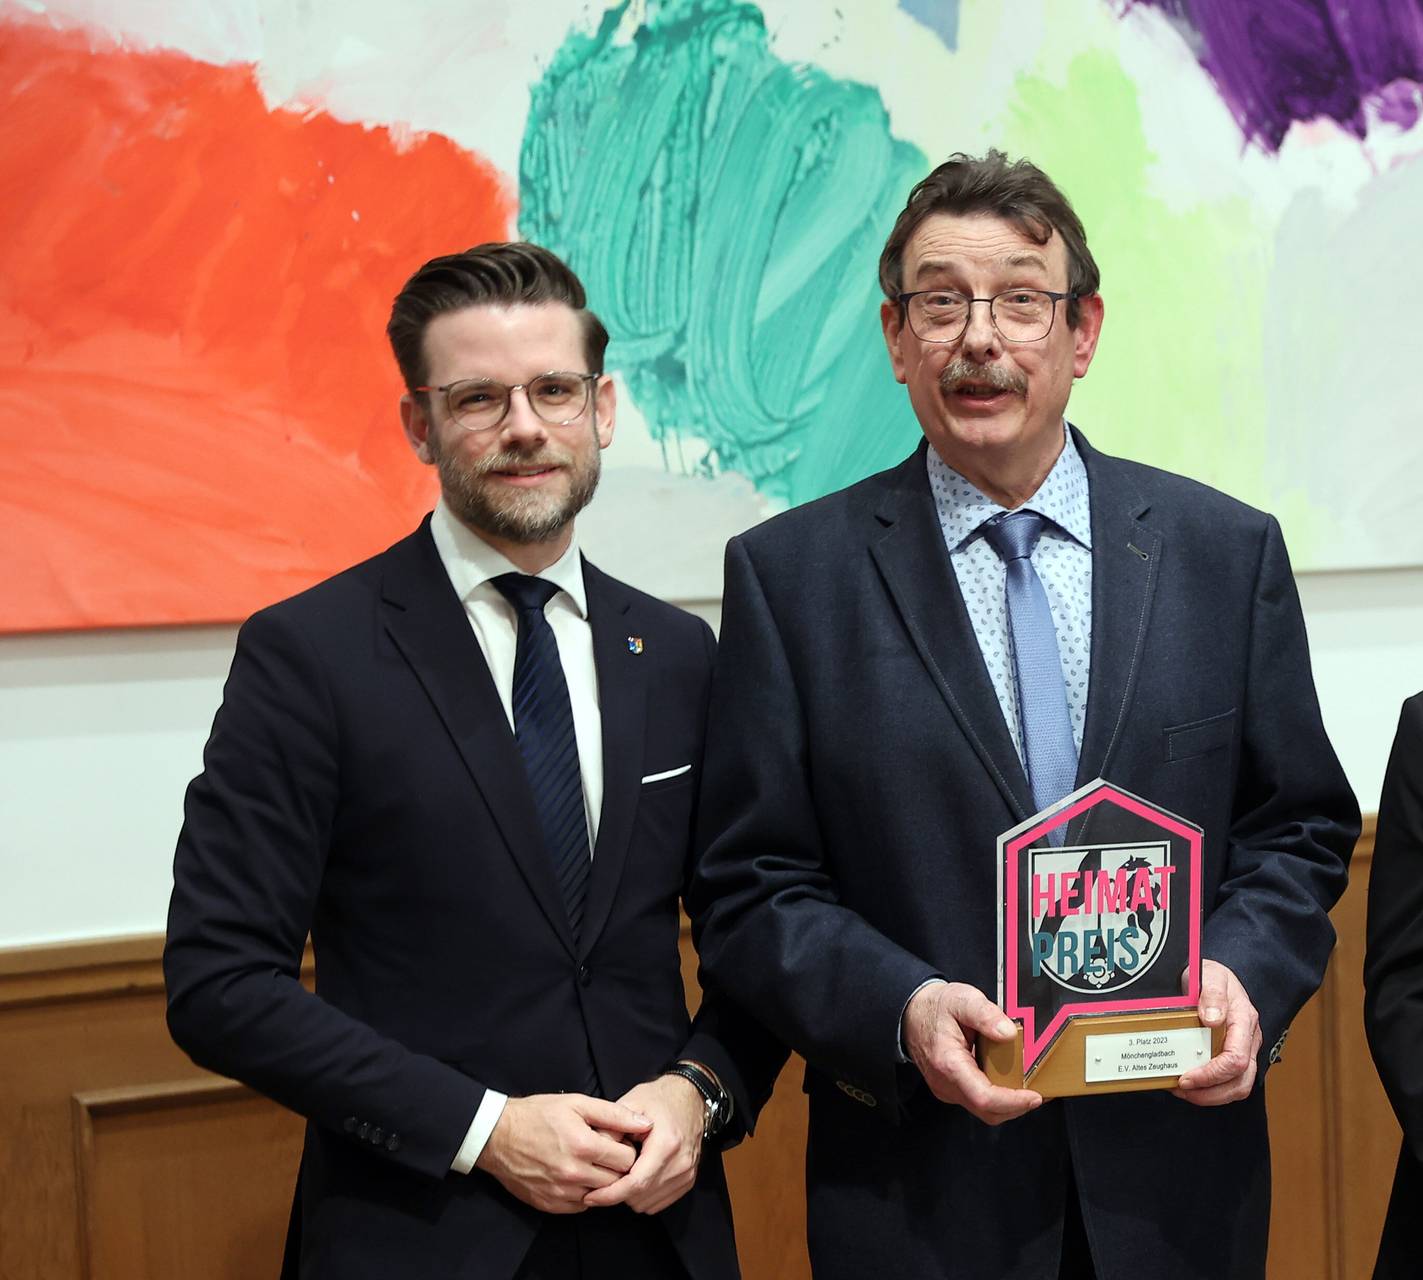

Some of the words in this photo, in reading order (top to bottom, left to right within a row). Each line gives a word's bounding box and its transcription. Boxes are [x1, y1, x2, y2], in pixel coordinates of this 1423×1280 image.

[1032, 866, 1176, 917] HEIMAT
[1032, 926, 1140, 977] PREIS
[1121, 1050, 1175, 1060] Mönchengladbach
[1148, 1062, 1178, 1071] Zeughaus
